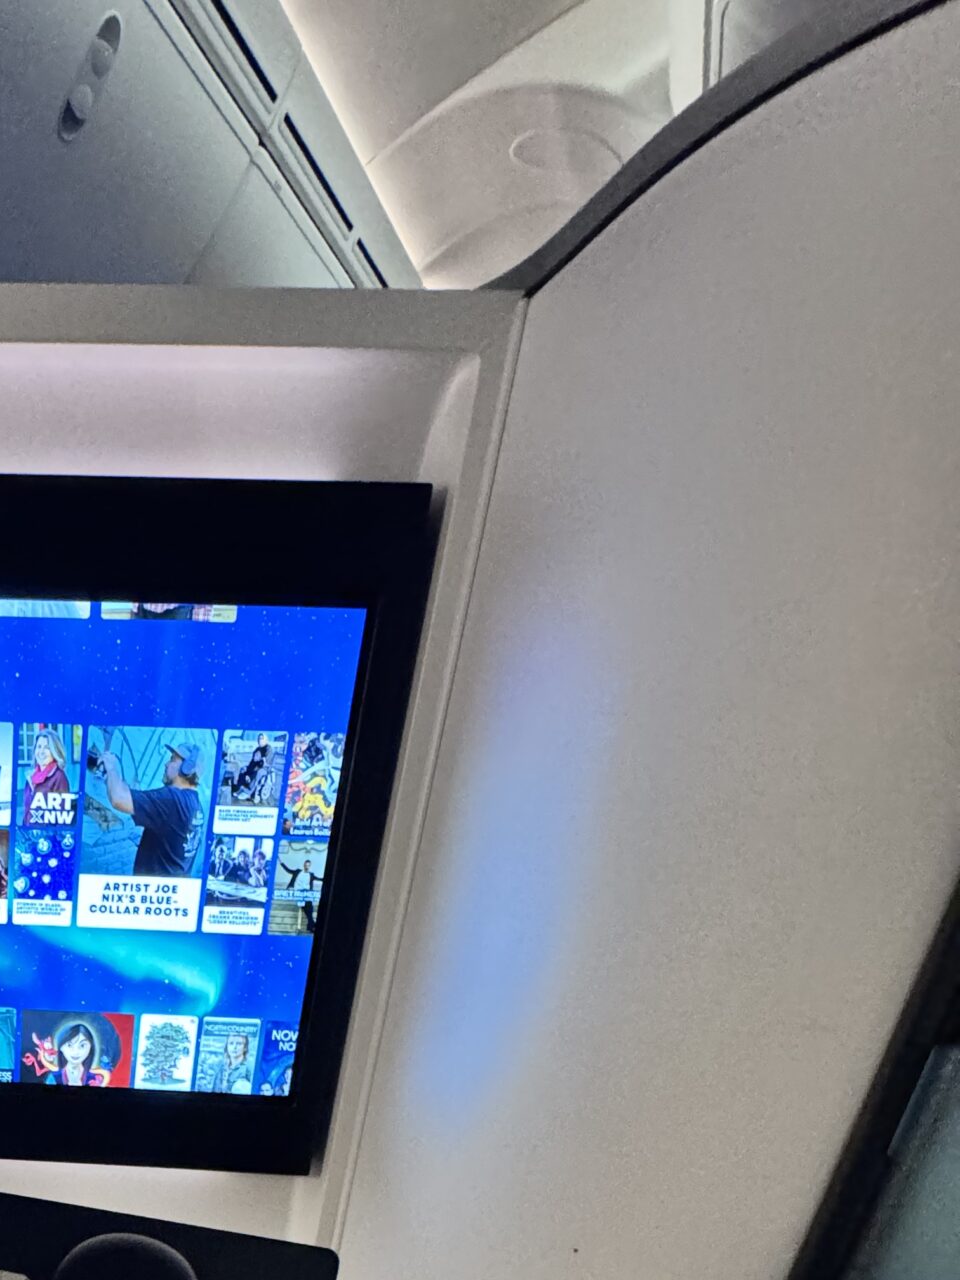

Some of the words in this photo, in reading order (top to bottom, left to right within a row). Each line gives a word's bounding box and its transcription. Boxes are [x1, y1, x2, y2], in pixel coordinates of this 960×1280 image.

[30, 791, 77, 811] ART
[103, 882, 151, 893] ARTIST
[154, 884, 179, 894] JOE
[101, 893, 136, 904] NIX'S
[140, 895, 179, 906] BLUE-
[89, 904, 140, 915] COLLAR
[145, 906, 189, 917] ROOTS
